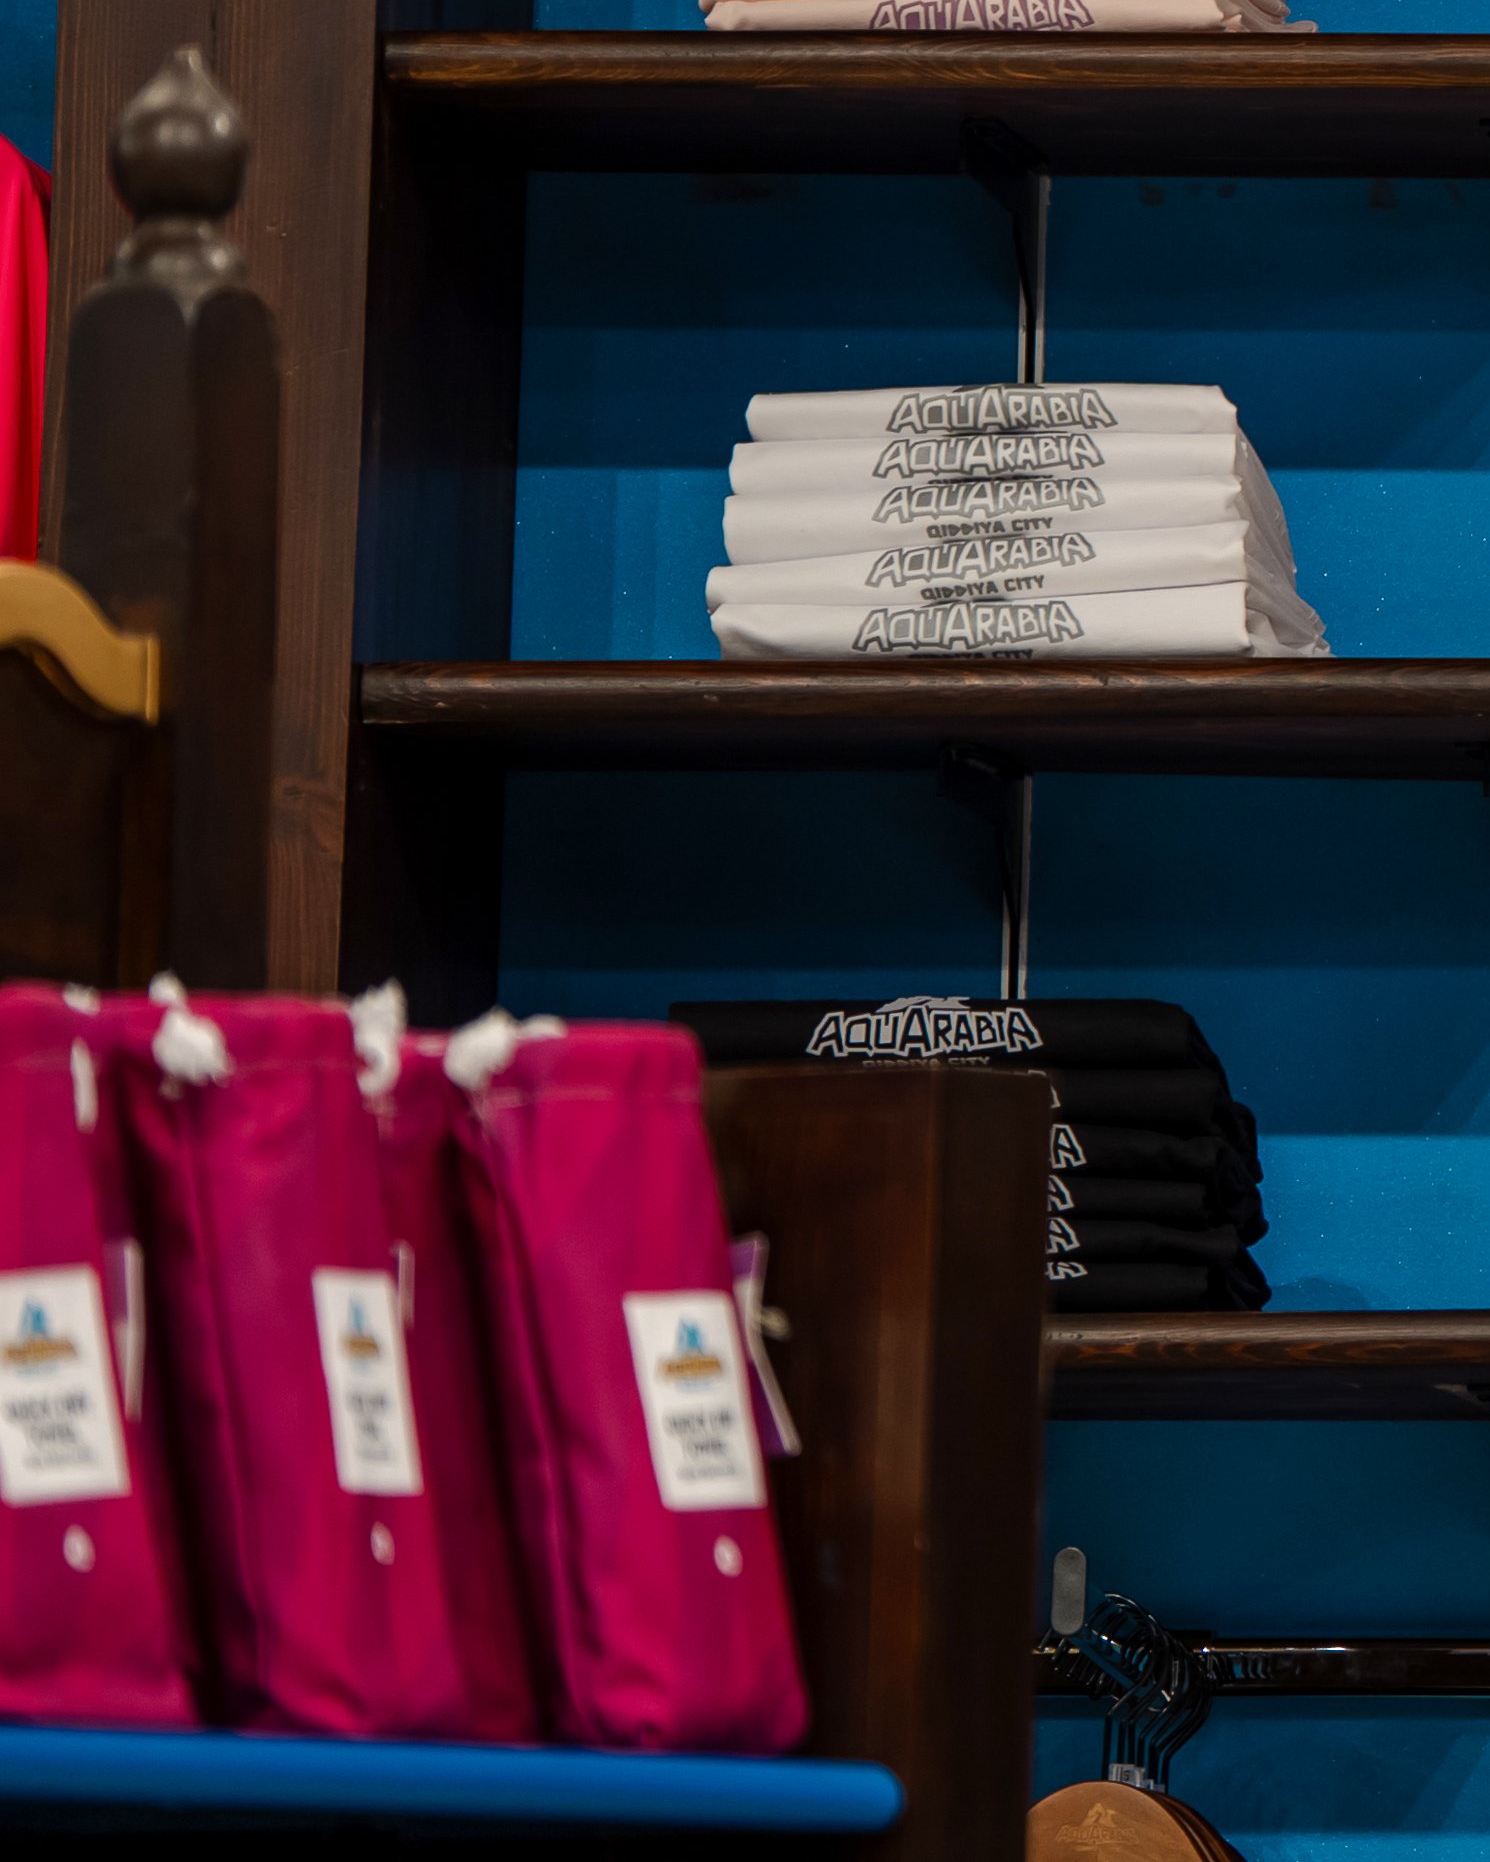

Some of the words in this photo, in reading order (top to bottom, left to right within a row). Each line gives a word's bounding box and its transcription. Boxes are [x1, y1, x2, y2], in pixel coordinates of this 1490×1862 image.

[886, 387, 1118, 434] AQUARABIA
[872, 434, 1105, 478] AQUARABIA
[871, 477, 1105, 524] AQUARABIA
[927, 523, 1005, 538] QIDDIYA
[1012, 517, 1053, 531] CITY
[865, 533, 1096, 588] AQUARABIA
[921, 582, 999, 600] QIDDIYA
[1004, 575, 1045, 592] CITY
[852, 600, 1084, 652] AQUARABIA
[806, 1005, 1044, 1057] AQUARABIA
